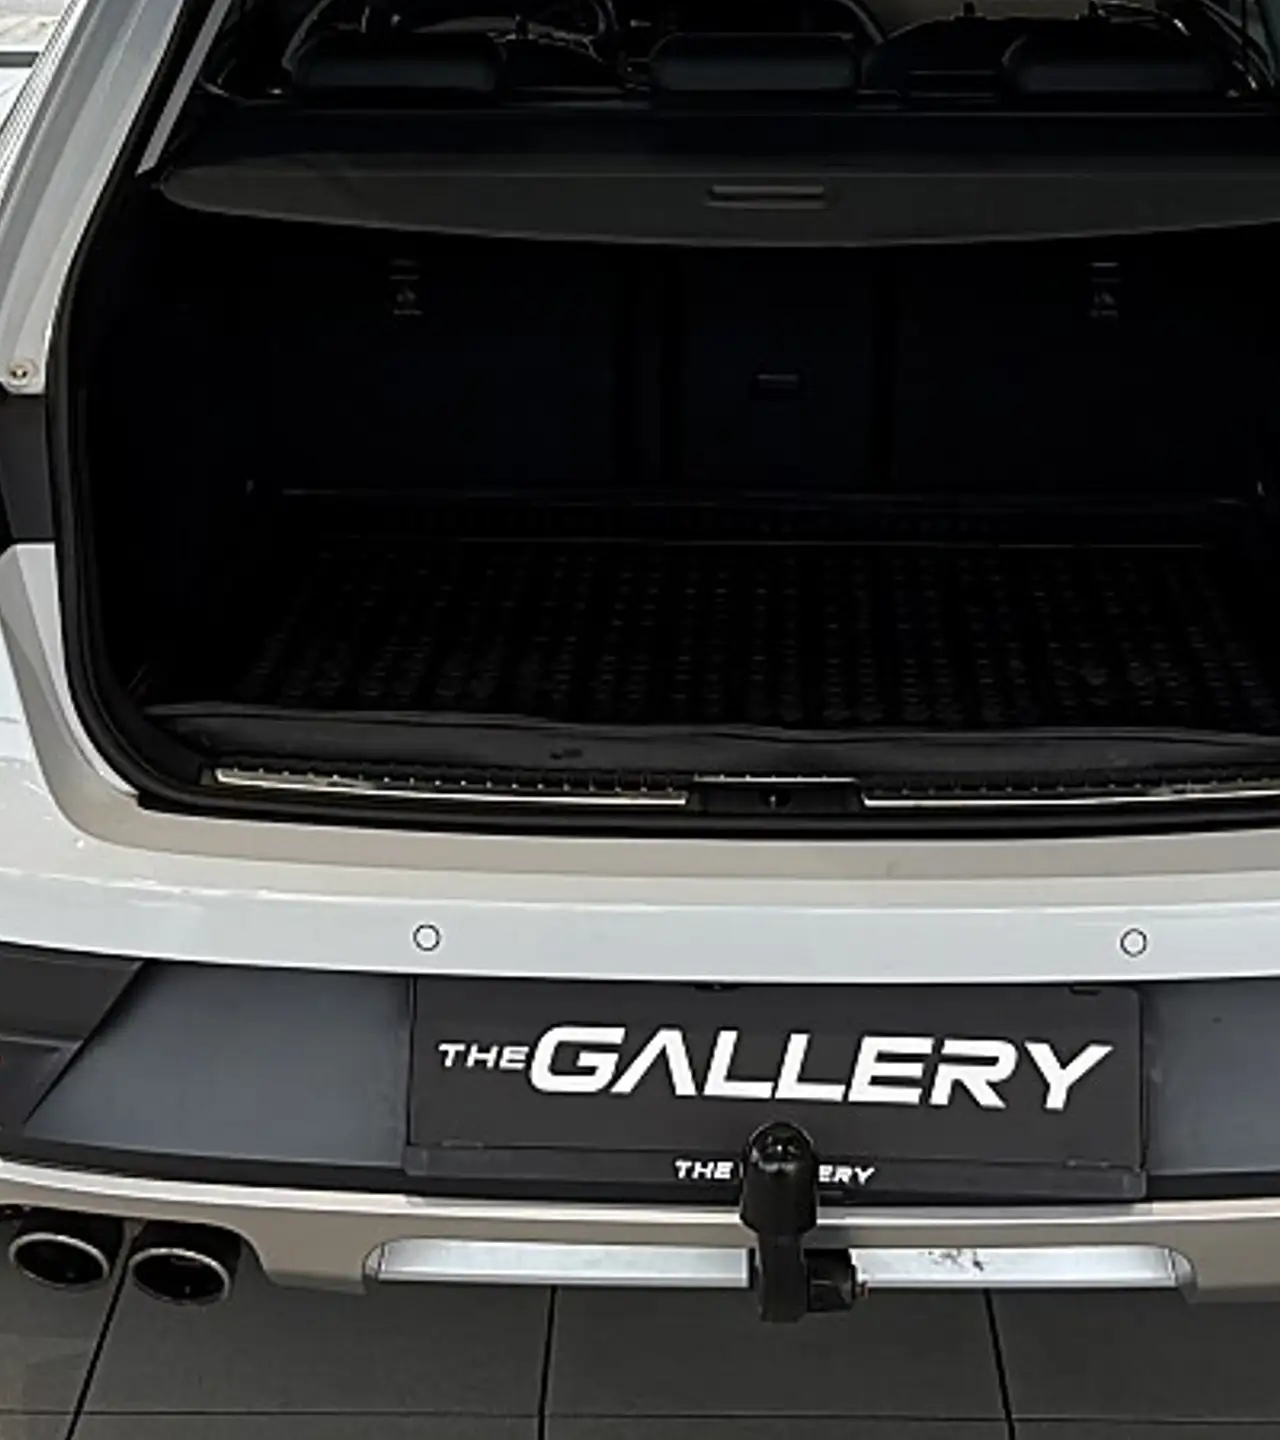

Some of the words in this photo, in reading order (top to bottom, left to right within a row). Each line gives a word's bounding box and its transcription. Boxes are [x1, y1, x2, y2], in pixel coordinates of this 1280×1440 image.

[437, 1042, 529, 1071] THE
[528, 1025, 1113, 1110] GALLERY
[675, 1159, 734, 1180] THE
